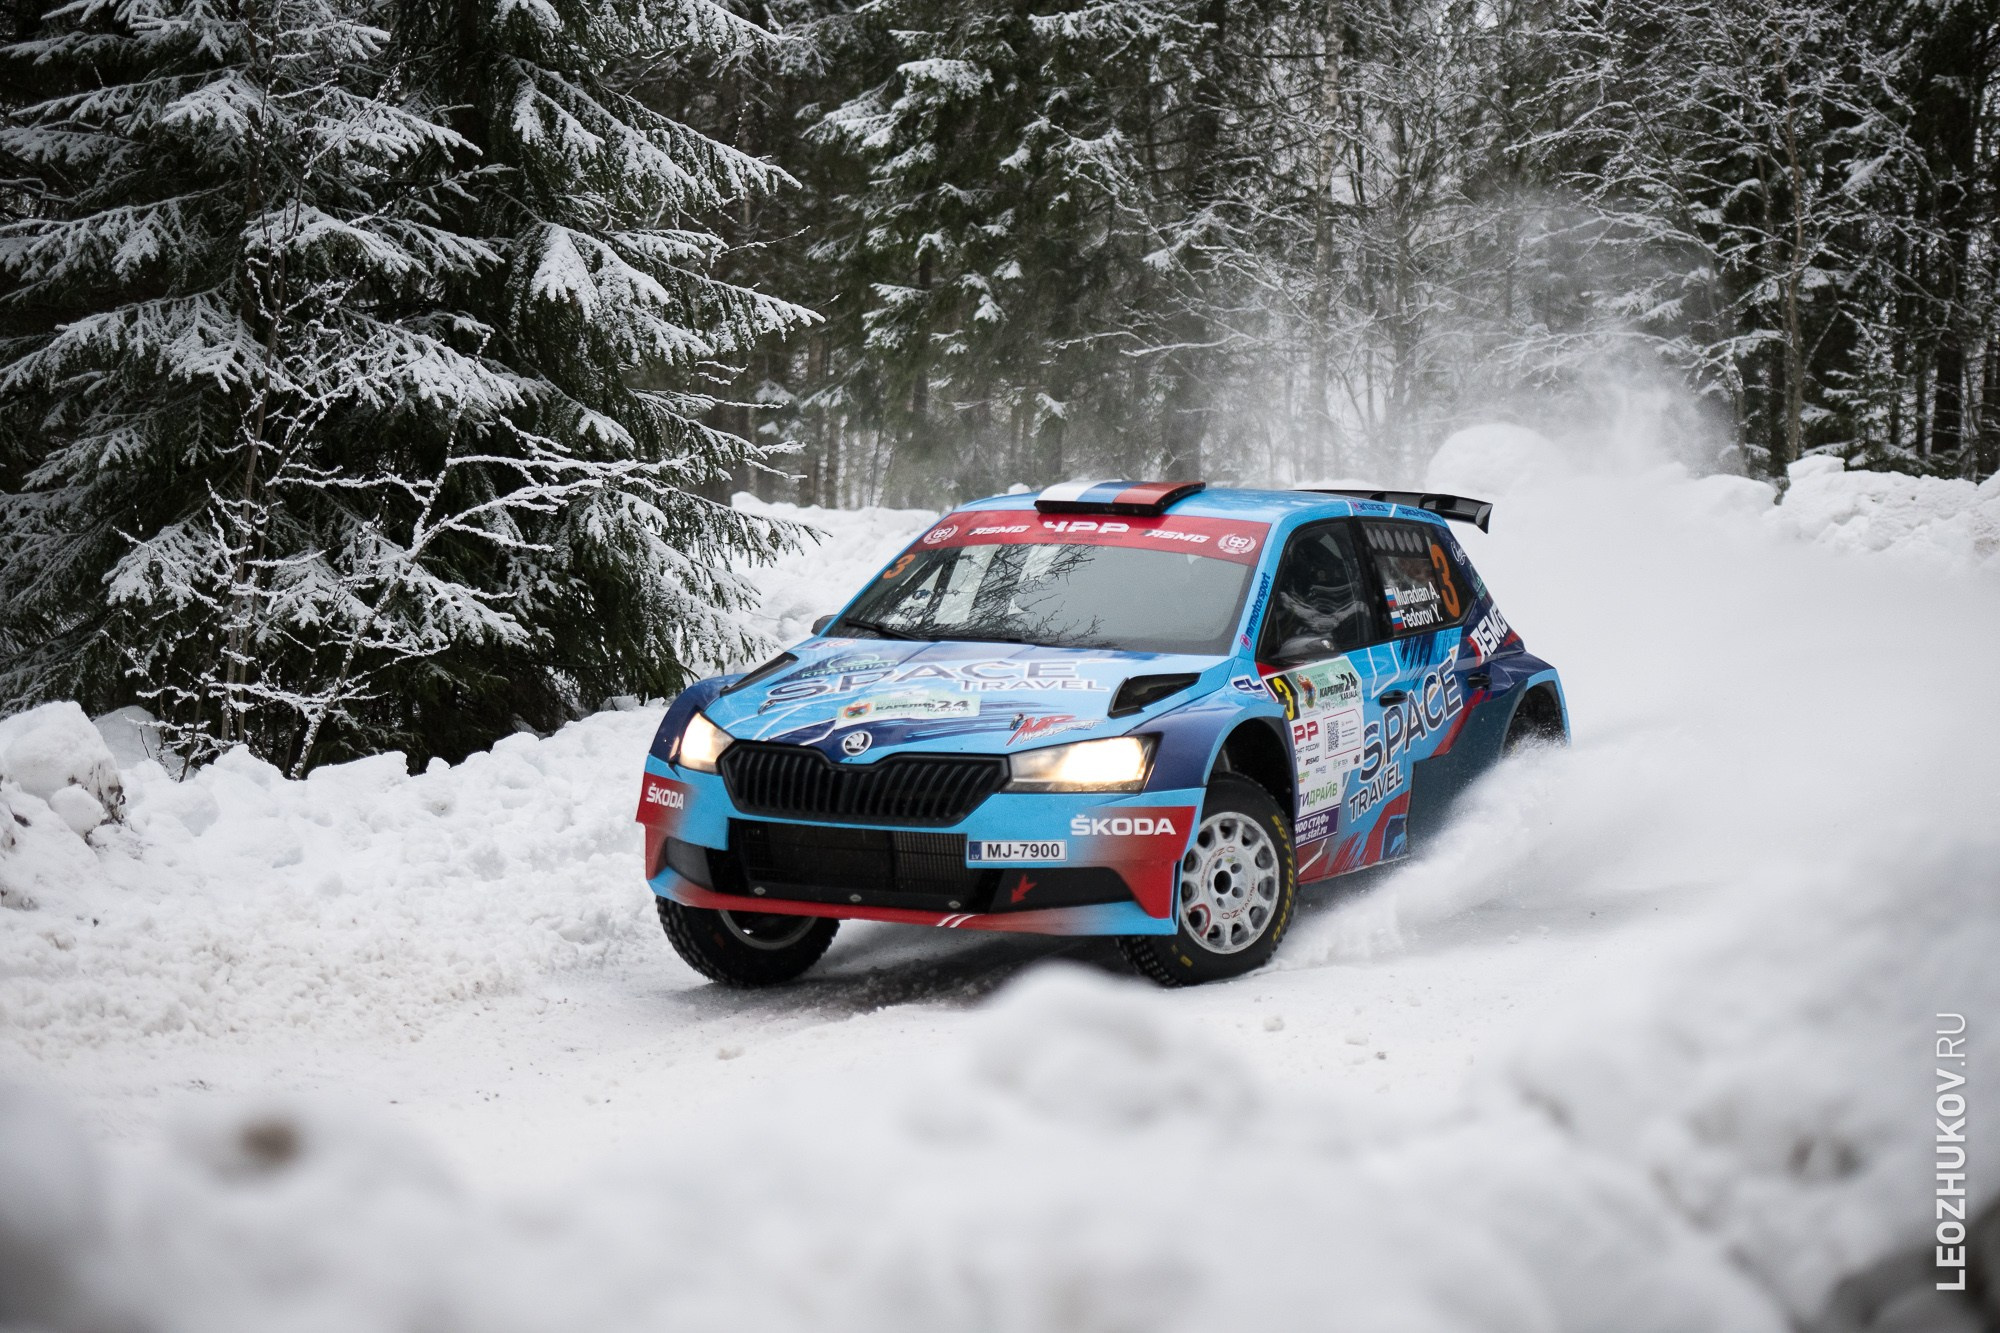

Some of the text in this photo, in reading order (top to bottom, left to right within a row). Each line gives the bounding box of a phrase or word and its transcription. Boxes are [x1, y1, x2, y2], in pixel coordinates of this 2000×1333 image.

[970, 525, 1031, 536] ASMG
[1146, 529, 1211, 544] ASMG
[882, 553, 916, 579] 3
[1393, 581, 1441, 606] Muradian A.
[1430, 543, 1461, 618] 3
[1244, 572, 1271, 638] mrmotorsport
[1400, 603, 1444, 629] Fedorov Y.
[1470, 601, 1509, 664] ASMG
[767, 659, 1080, 700] SPACE
[958, 679, 1110, 691] TRAVEL
[1273, 677, 1294, 721] 3
[1340, 690, 1358, 700] KARJALA
[1293, 720, 1319, 746] РР
[1358, 657, 1464, 783] SPACE
[645, 782, 684, 810] ŠKODA
[1299, 782, 1338, 807] ТИДРАЙВ
[1348, 761, 1404, 823] TRAVEL
[1069, 814, 1177, 836] ŠKODA
[986, 843, 1061, 859] MJ-7900
